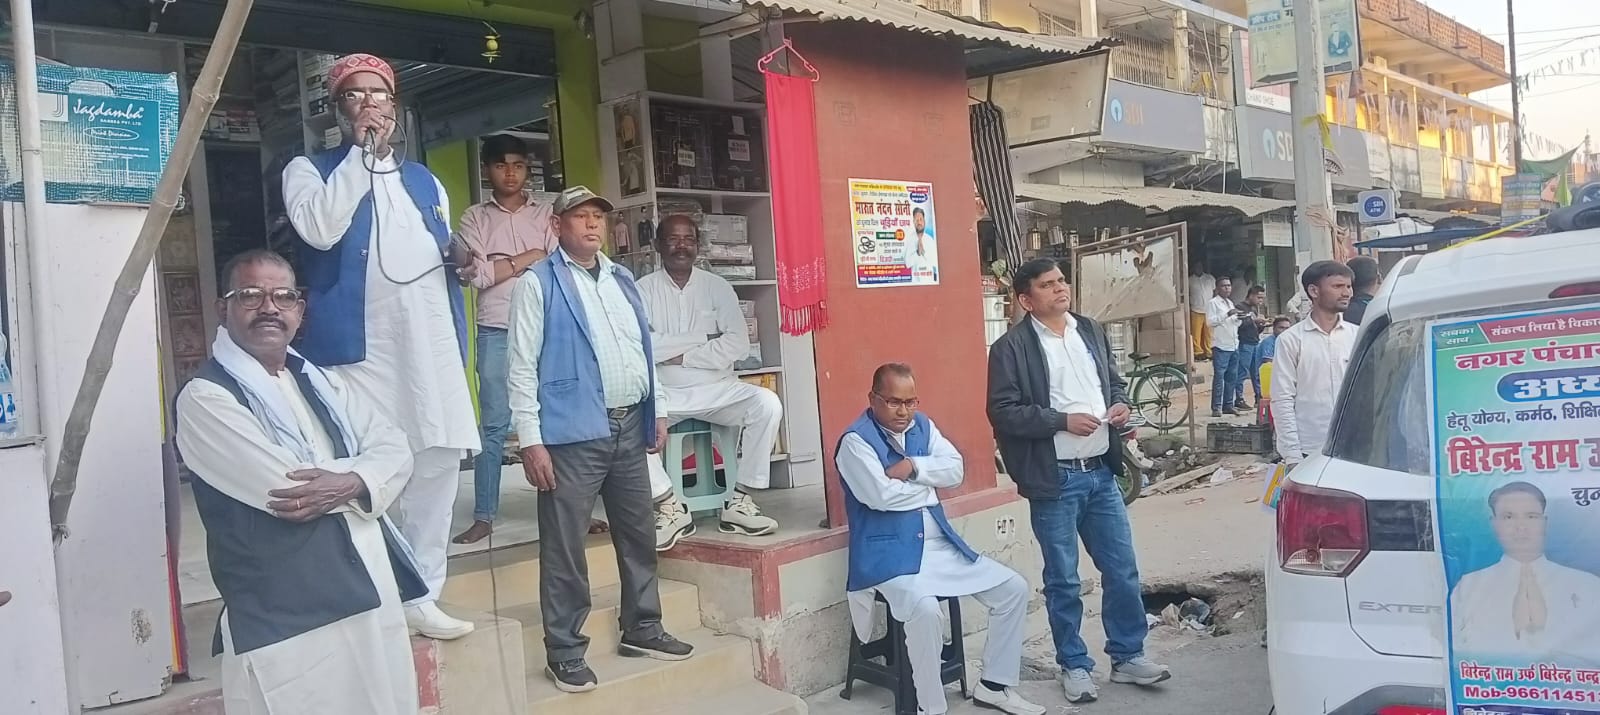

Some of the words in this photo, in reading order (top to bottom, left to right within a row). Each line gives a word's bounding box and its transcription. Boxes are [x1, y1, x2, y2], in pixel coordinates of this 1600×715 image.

[73, 98, 144, 121] Jagdamba
[876, 199, 892, 217] नंदन
[894, 200, 911, 218] सोनी
[1440, 328, 1475, 338] सबका
[1491, 325, 1526, 336] संकल्प
[1529, 322, 1556, 332] लिया
[1558, 318, 1567, 330] है
[1456, 350, 1525, 369] नगर
[1532, 341, 1600, 362] पंचा
[1513, 376, 1600, 399] अध्य
[1447, 411, 1471, 432] हेतू
[1472, 408, 1511, 424] योग्य,
[1516, 404, 1557, 422] कर्मठ,
[1448, 436, 1522, 473] बिरेन्द्र
[1528, 439, 1579, 469] राम
[1359, 601, 1442, 614] EXTER
[1461, 662, 1492, 680] बिरेन्द्र
[1495, 667, 1513, 680] राम
[1518, 665, 1535, 681] उर्फ
[1539, 664, 1571, 683] बिरेन्द्र
[1464, 686, 1600, 703] Mob-96611451
